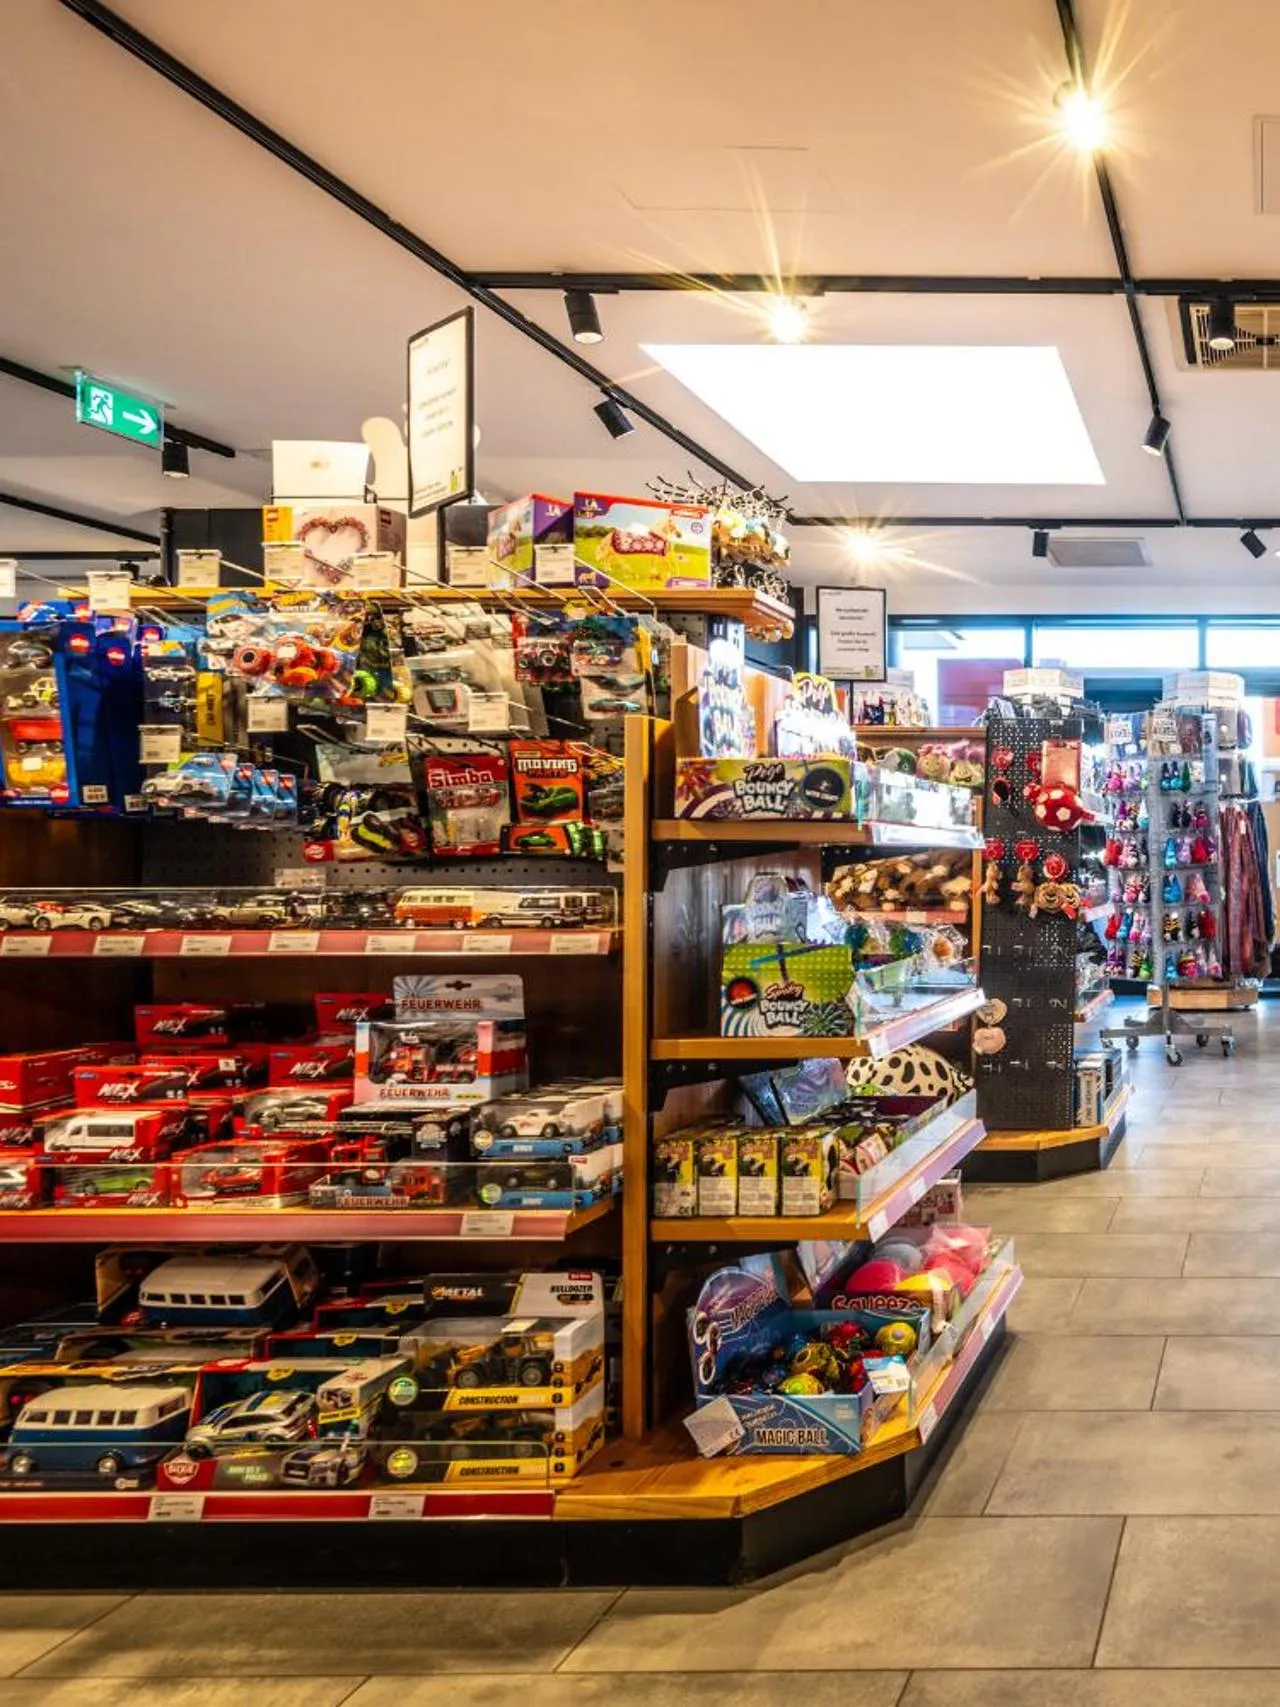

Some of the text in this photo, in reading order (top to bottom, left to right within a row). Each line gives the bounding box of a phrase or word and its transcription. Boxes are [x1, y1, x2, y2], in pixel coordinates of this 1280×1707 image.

[516, 759, 577, 773] MOVING
[428, 769, 493, 789] Simba
[735, 779, 794, 796] BOUNCY
[743, 795, 785, 812] BALL
[401, 999, 483, 1011] FEUERWEHR
[760, 1000, 808, 1012] BOUNCY
[766, 1012, 801, 1025] BALL
[97, 1080, 140, 1100] NEX
[379, 1087, 450, 1099] FEUERWEHR
[459, 1395, 519, 1406] CONSTRUCTION
[755, 1427, 796, 1445] MAGIC
[798, 1427, 829, 1445] BALL
